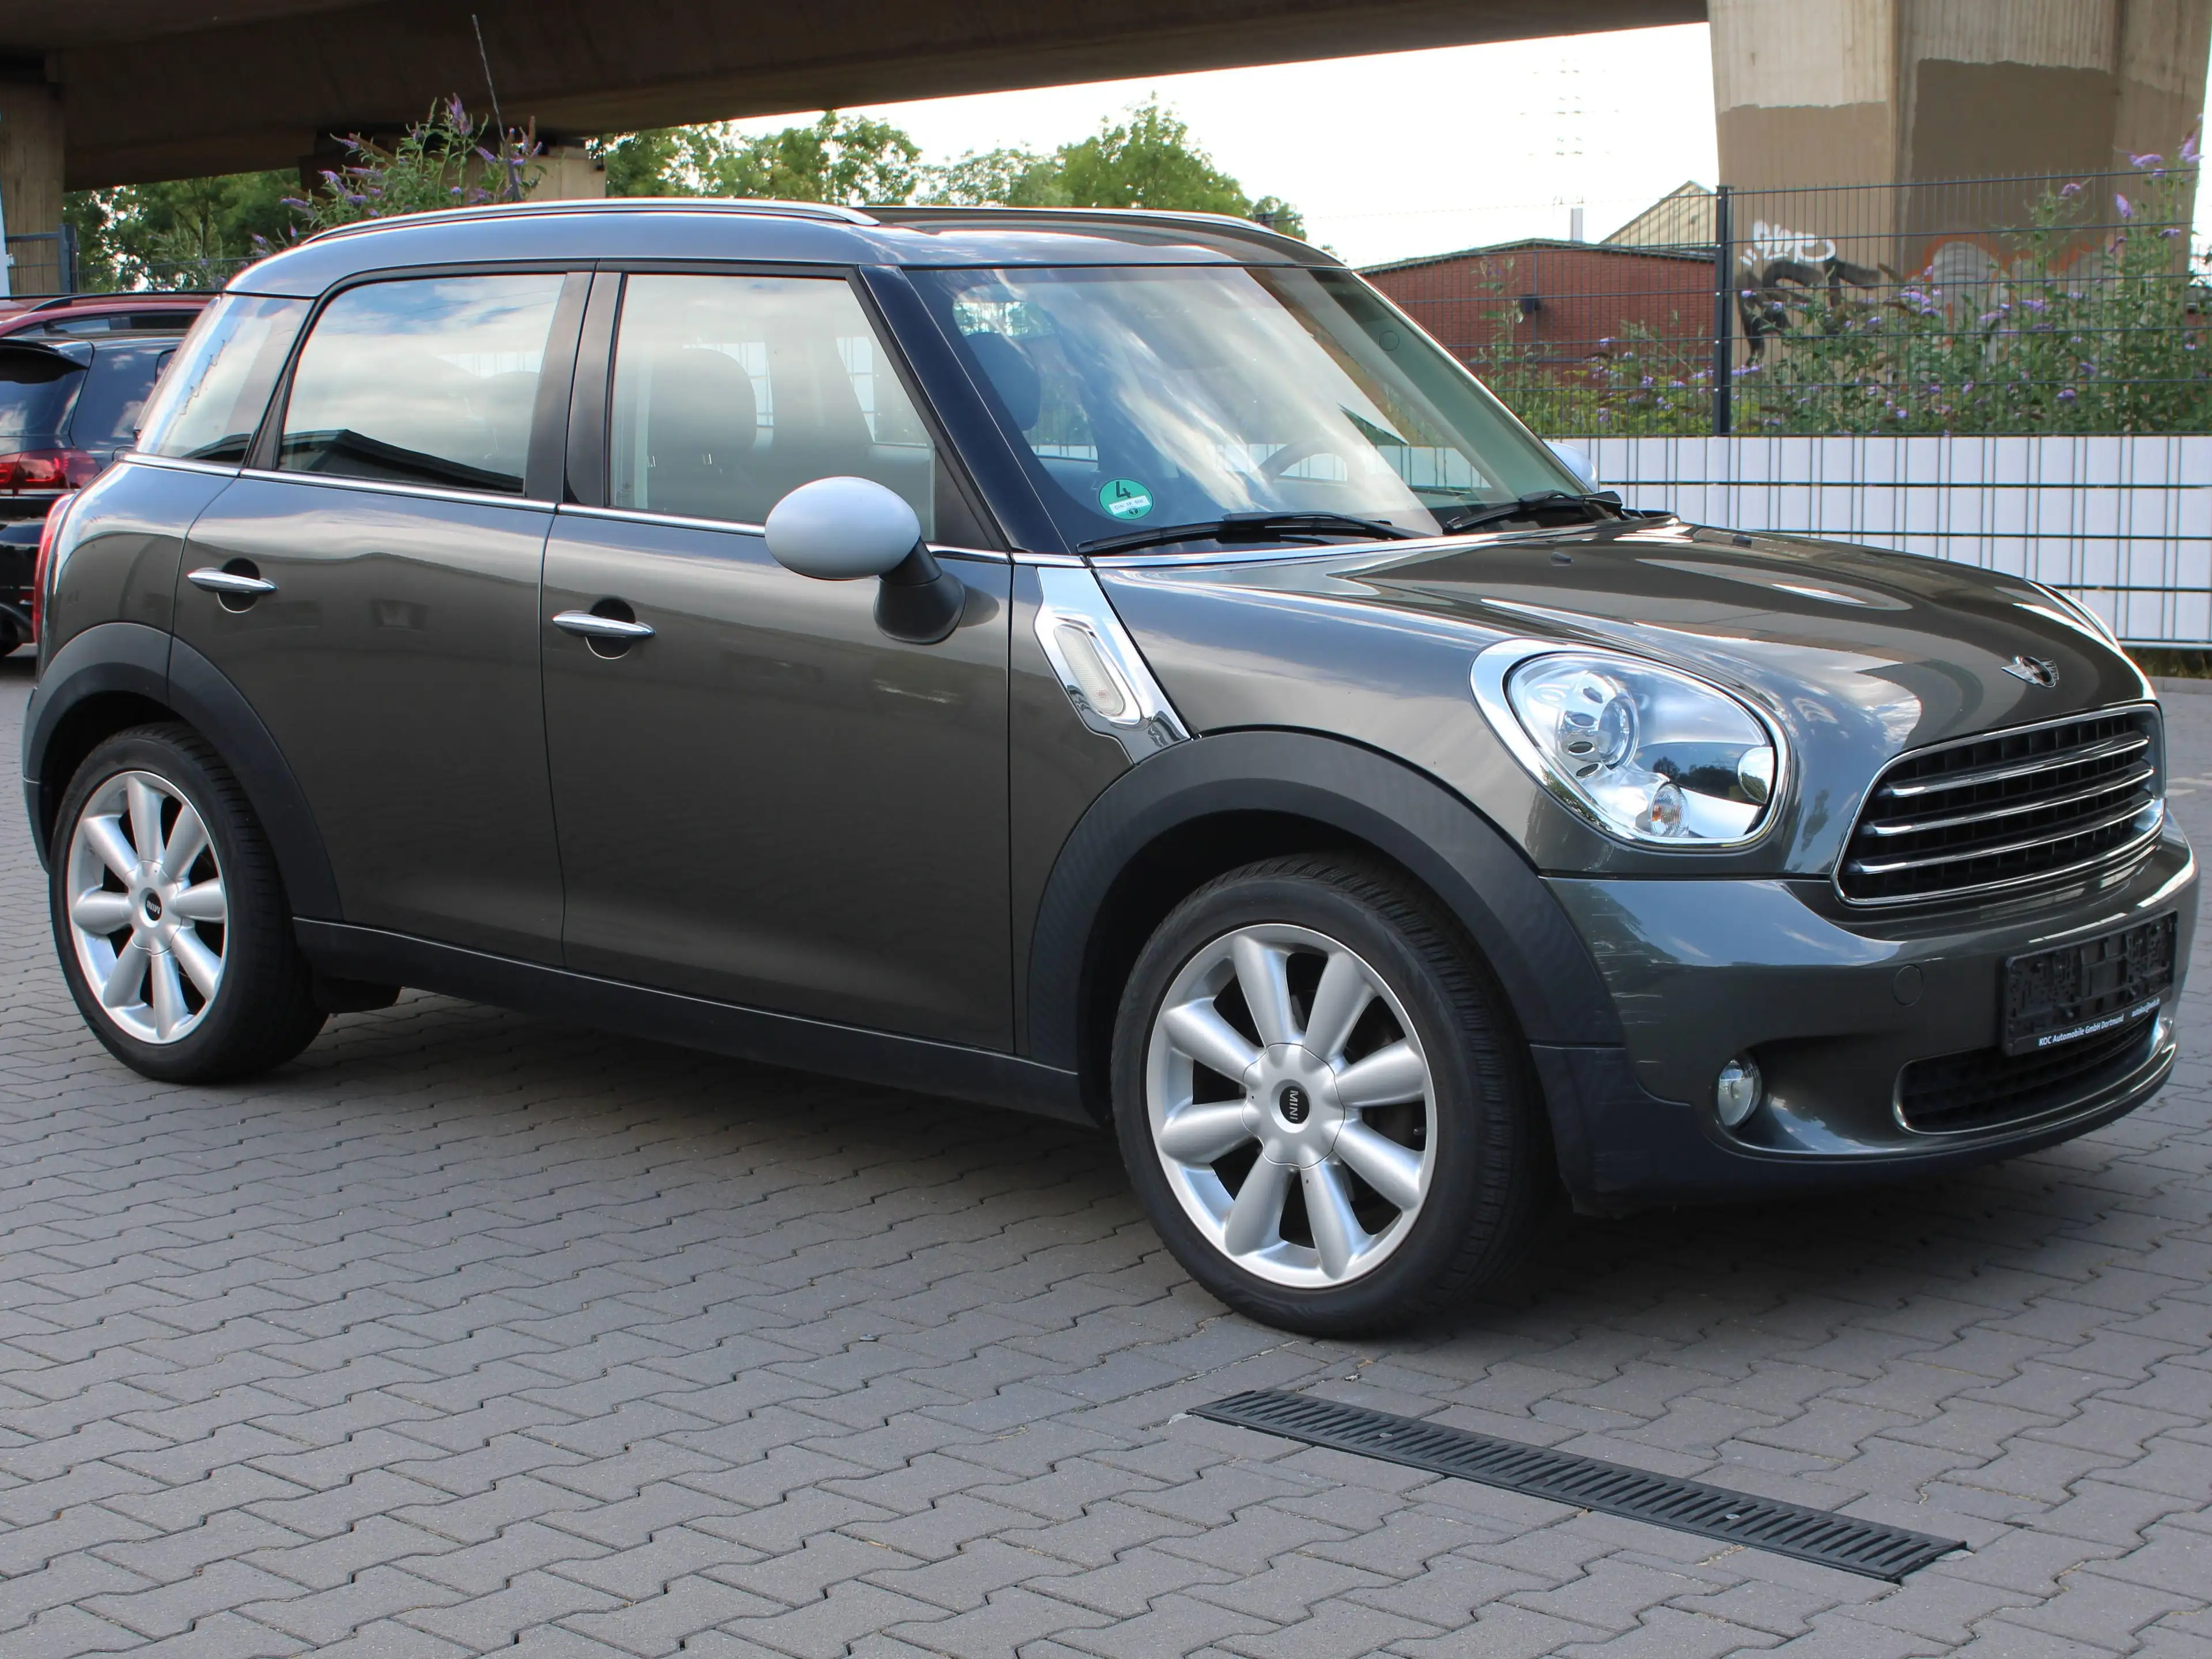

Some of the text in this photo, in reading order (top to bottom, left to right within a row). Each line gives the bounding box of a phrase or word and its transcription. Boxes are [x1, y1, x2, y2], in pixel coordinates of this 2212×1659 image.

[1116, 480, 1131, 498] 4
[146, 900, 161, 914] MINI
[2039, 1036, 2052, 1046] KOC
[2052, 1027, 2085, 1043] Automobile
[2085, 1022, 2101, 1034] GmbH
[2101, 1013, 2124, 1029] Dortmund
[1289, 1090, 1299, 1120] MINI
